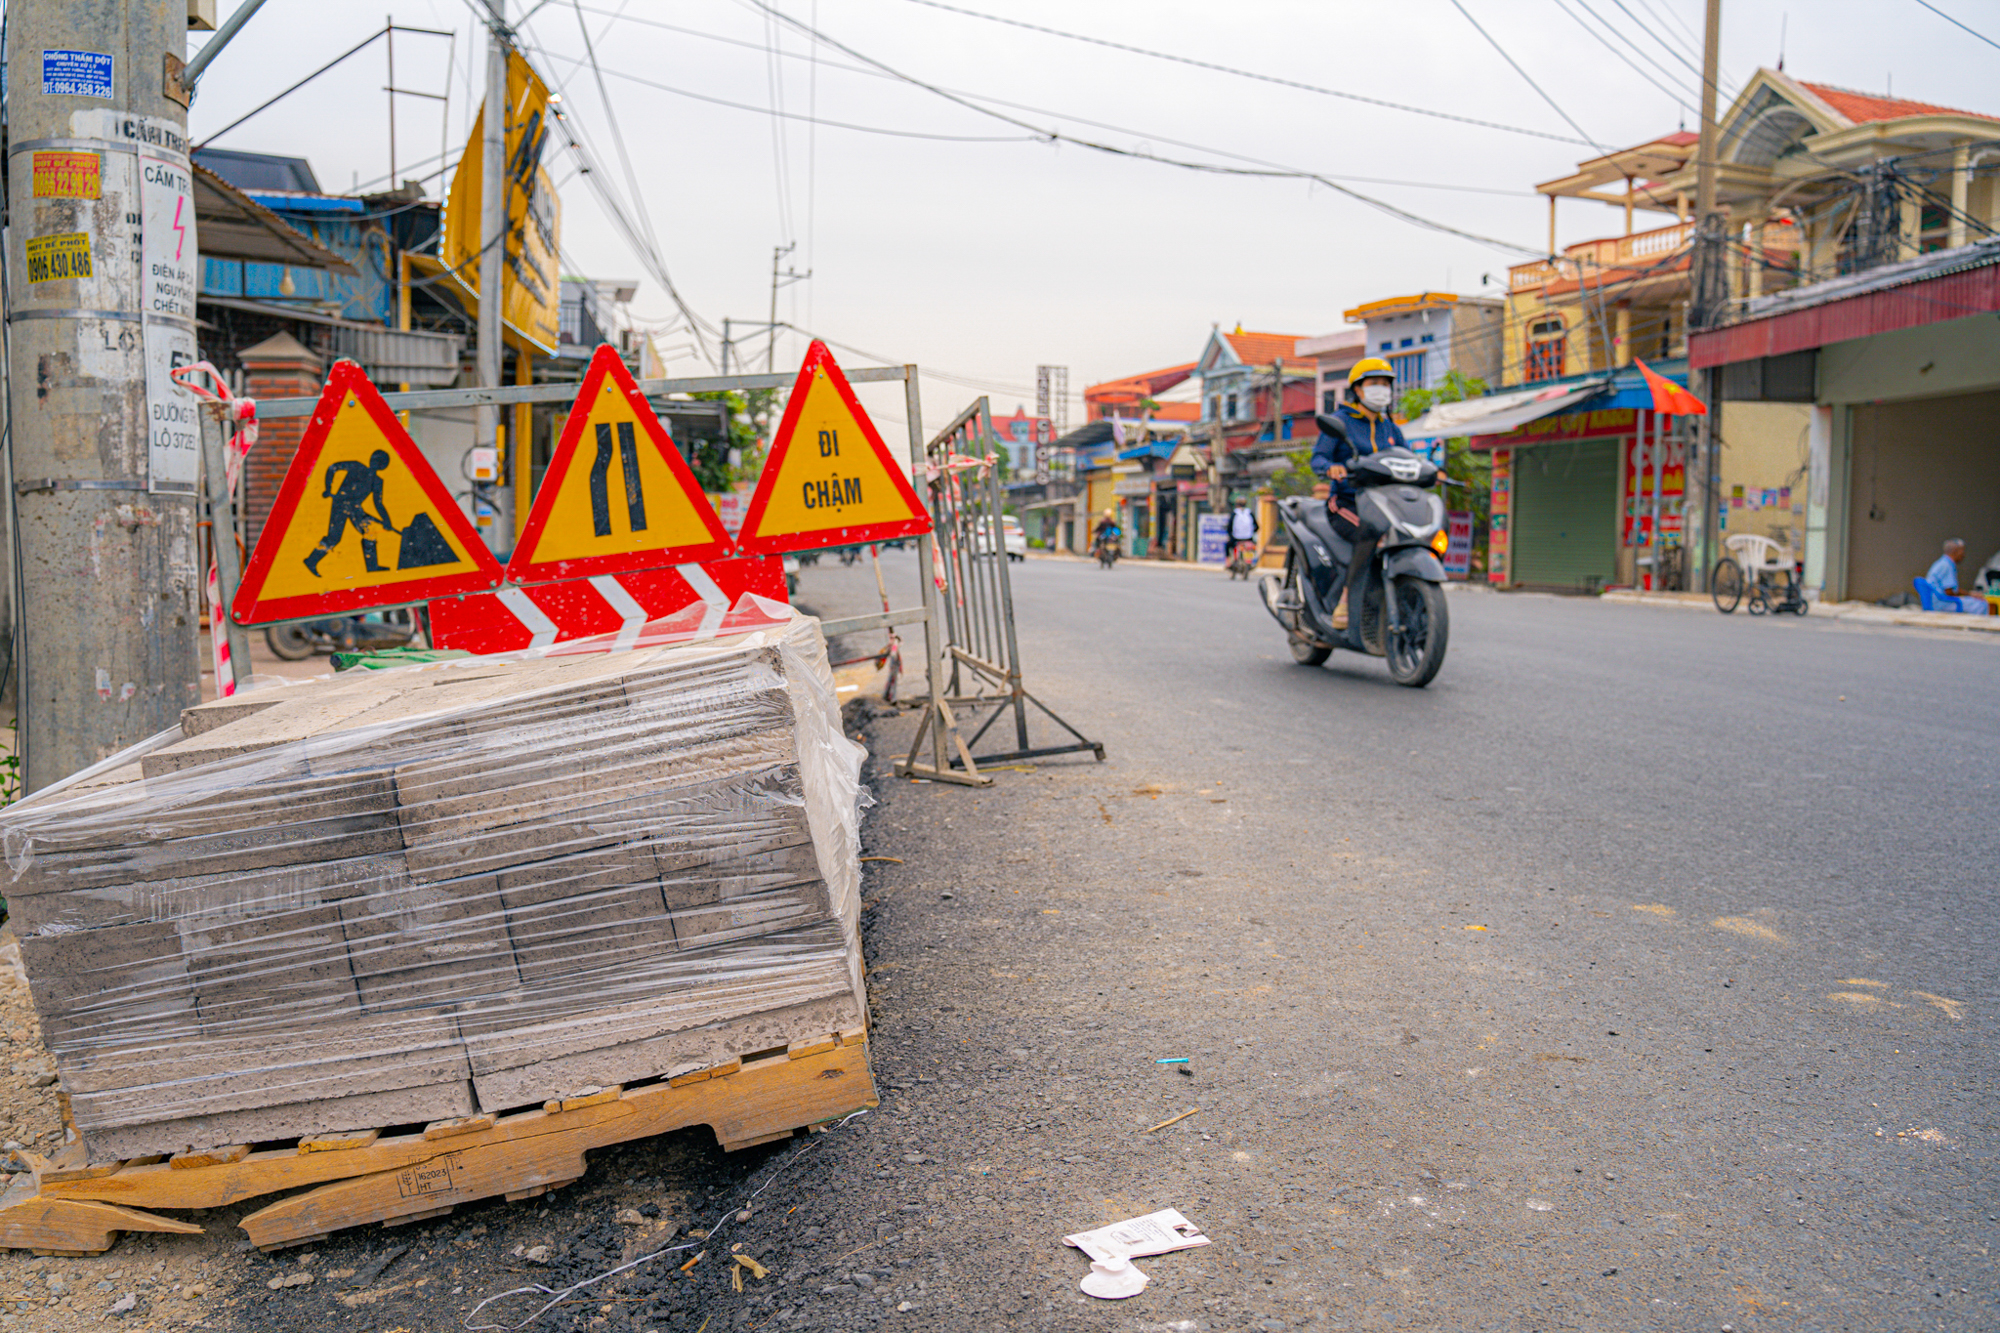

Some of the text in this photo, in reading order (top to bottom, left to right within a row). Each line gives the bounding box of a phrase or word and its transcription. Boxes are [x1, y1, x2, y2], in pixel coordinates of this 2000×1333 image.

[144, 164, 175, 189] CẤM
[154, 427, 172, 451] LỘ
[818, 429, 840, 458] ĐI
[802, 472, 863, 513] CHẬM
[419, 1182, 432, 1191] HT
